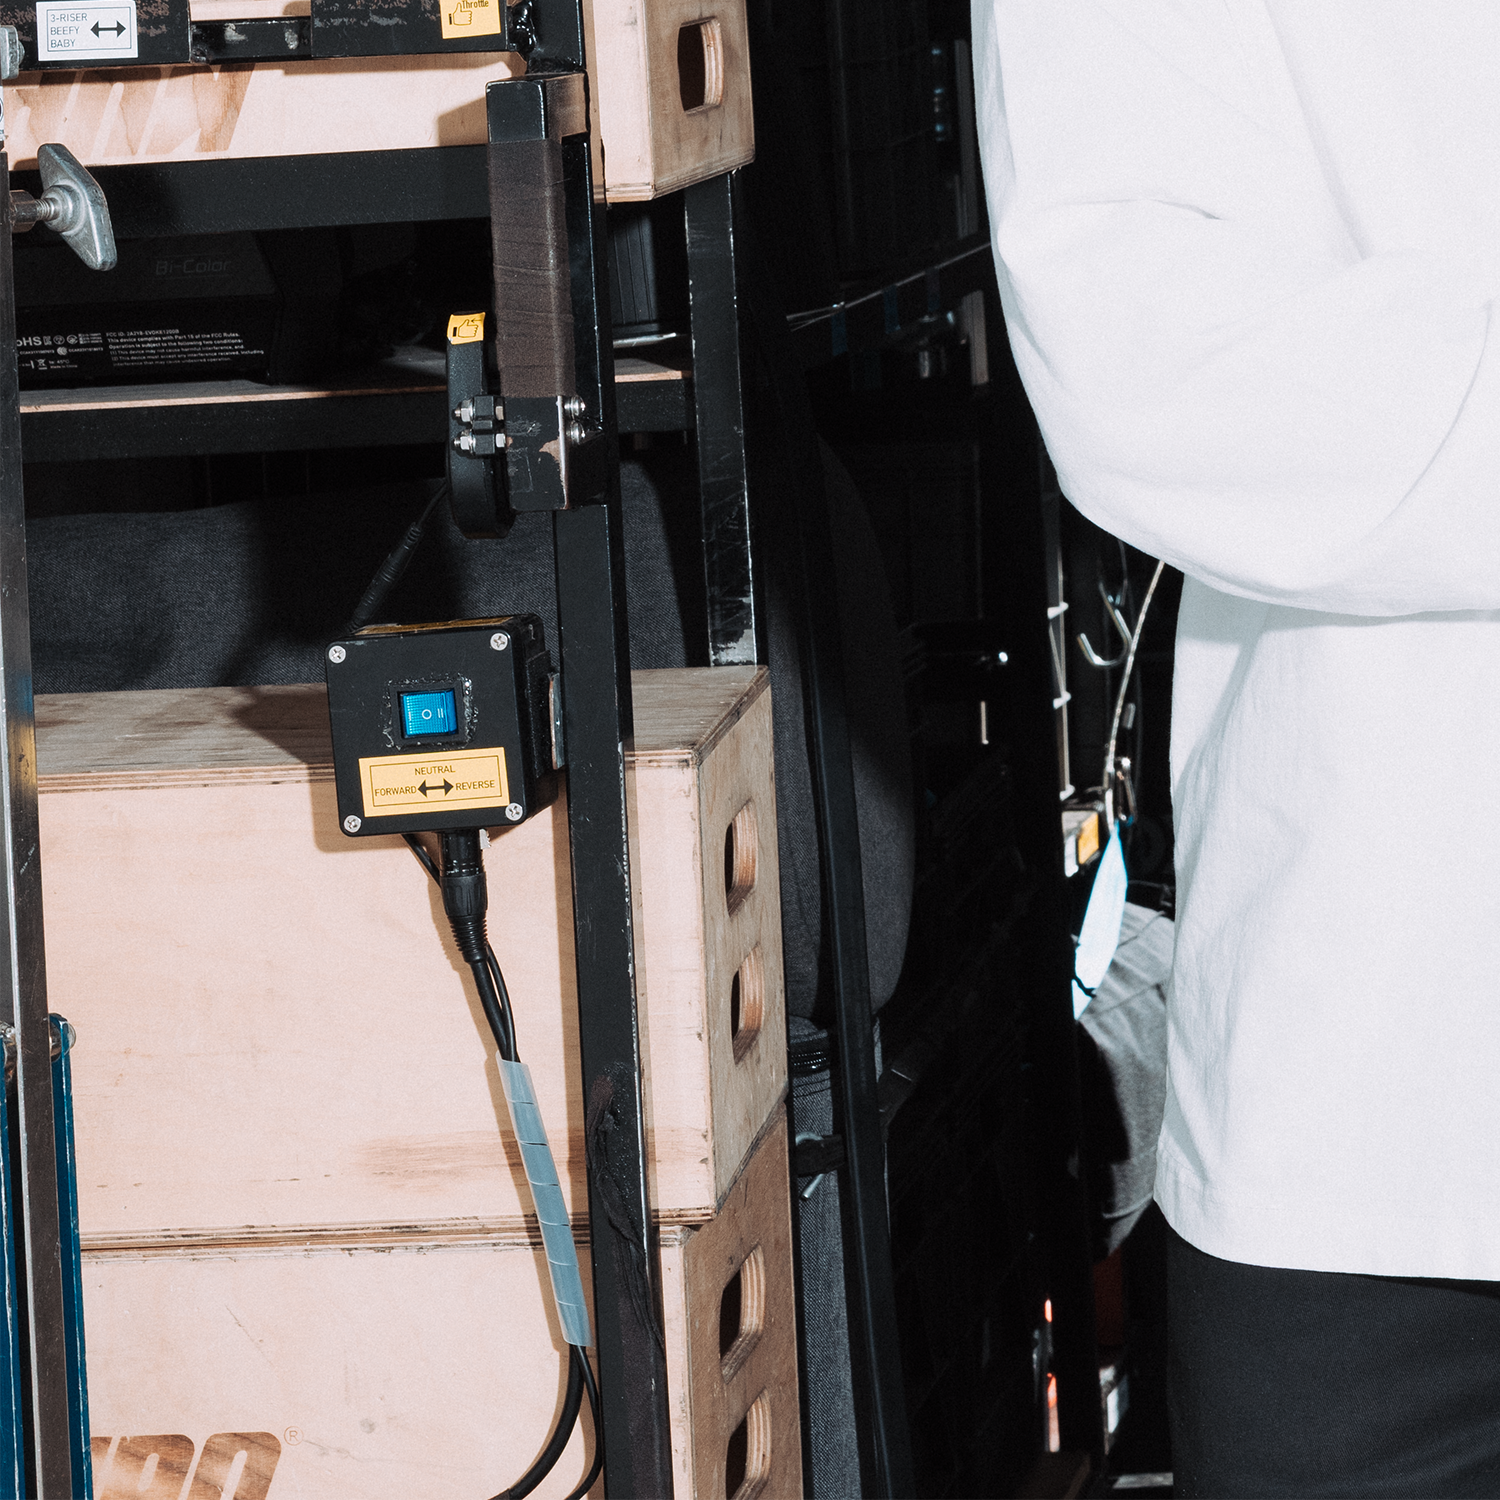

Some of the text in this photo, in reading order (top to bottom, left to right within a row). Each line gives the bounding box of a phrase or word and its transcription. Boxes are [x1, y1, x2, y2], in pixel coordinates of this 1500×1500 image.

[50, 12, 88, 22] 3-RISER
[50, 26, 80, 35] BEEFY
[50, 39, 76, 48] BABY
[156, 259, 231, 275] Bi-Color
[414, 765, 456, 776] NEUTRAL
[374, 780, 496, 797] FORWARD REVERSE
